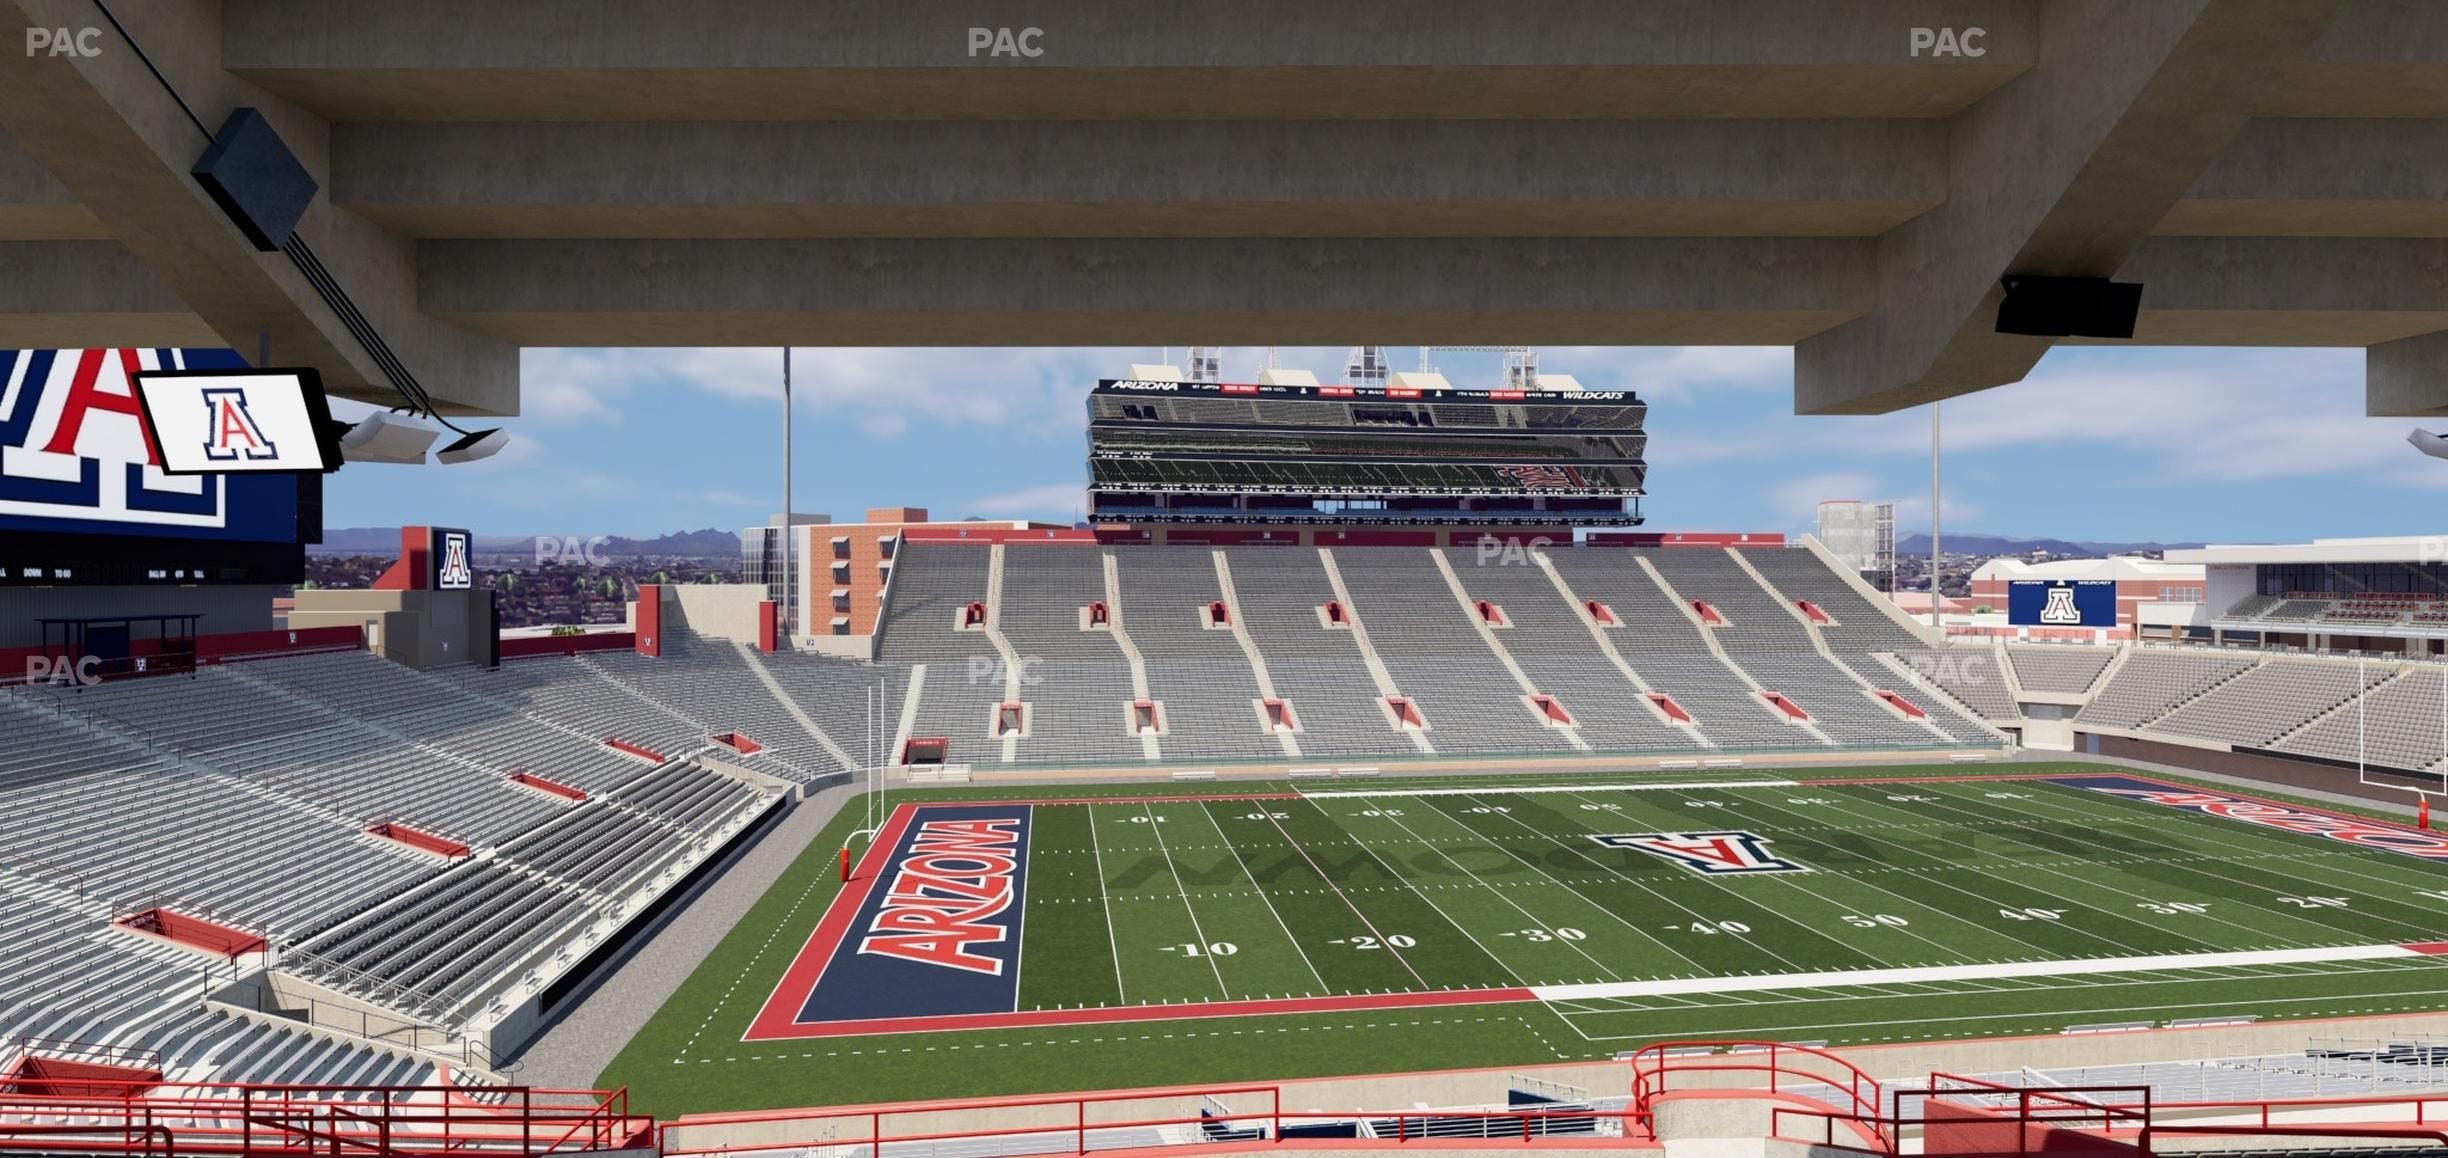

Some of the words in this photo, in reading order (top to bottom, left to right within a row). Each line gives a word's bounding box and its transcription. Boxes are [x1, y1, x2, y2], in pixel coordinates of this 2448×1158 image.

[1110, 380, 1179, 391] ARIZONA
[1562, 391, 1625, 400] WILDCATS
[201, 388, 279, 461] A
[440, 533, 472, 588] A
[2040, 588, 2081, 624] A
[1130, 815, 1169, 824] 10
[1246, 811, 1291, 821] 20
[1585, 830, 1816, 876] A
[856, 818, 1021, 977] ARIZONA
[2276, 895, 2348, 909] 20
[1999, 907, 2061, 921] 40
[2136, 901, 2206, 915] 30
[1691, 920, 1751, 935] 40
[1840, 914, 1909, 929] 50
[1351, 934, 1416, 950] 20
[1521, 927, 1587, 942] 30
[1177, 941, 1238, 958] 10
